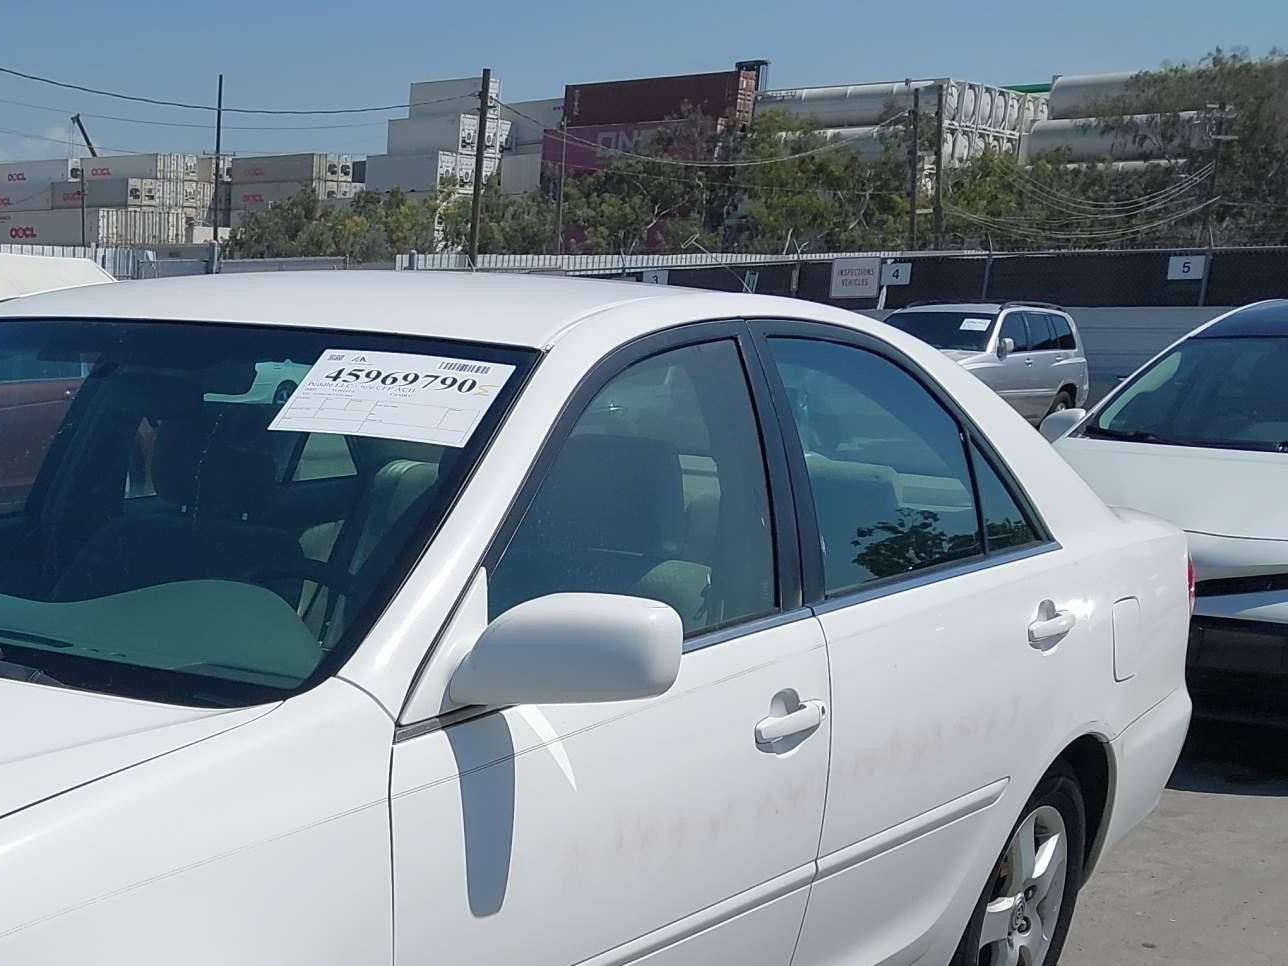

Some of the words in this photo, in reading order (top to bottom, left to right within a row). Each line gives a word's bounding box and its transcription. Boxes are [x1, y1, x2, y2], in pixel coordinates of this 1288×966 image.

[7, 172, 26, 181] OOCL
[91, 167, 111, 176] OOCL
[9, 226, 37, 239] OOCL
[892, 268, 899, 279] 4
[1182, 261, 1191, 274] 5
[324, 367, 477, 394] 45969790
